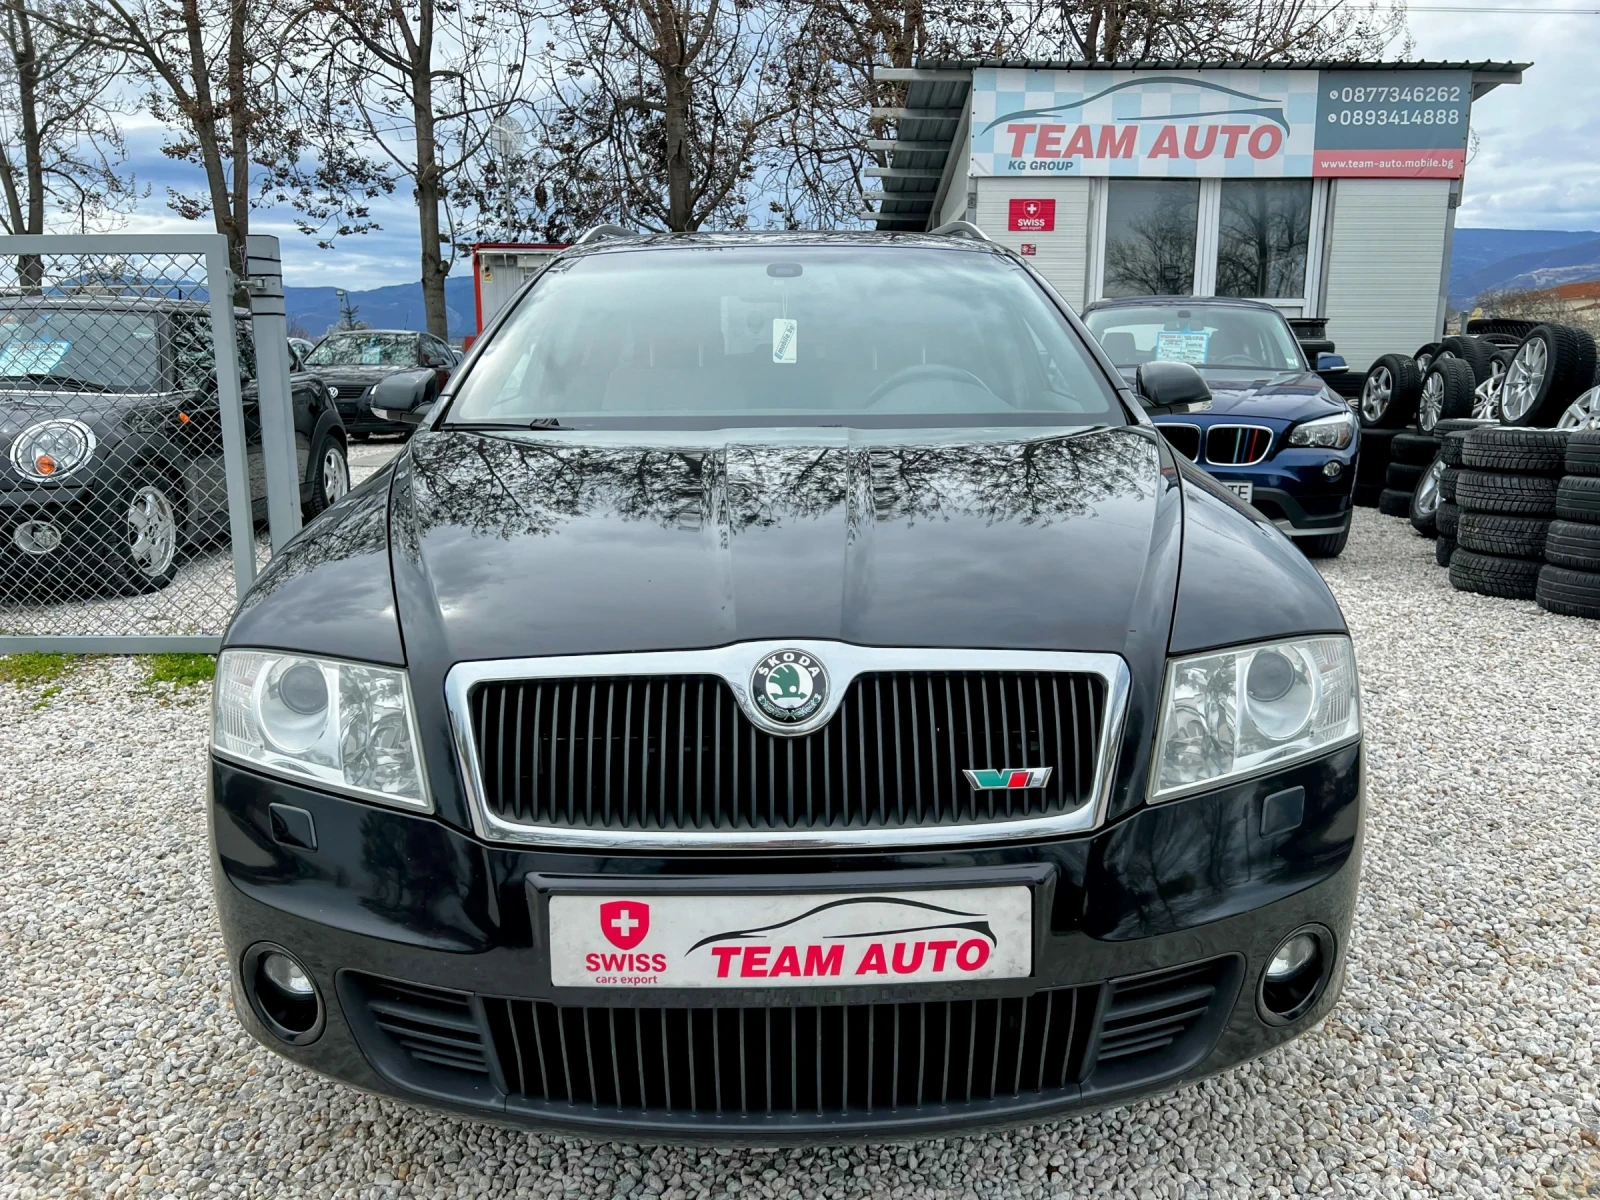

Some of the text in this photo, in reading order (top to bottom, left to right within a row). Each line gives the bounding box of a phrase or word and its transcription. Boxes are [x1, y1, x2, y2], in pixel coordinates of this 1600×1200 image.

[1341, 87, 1460, 102] 0877346262
[1340, 109, 1459, 125] 0893414888
[1007, 124, 1282, 159] TEAM AUTO
[1008, 160, 1073, 170] KG GROUP
[1321, 158, 1453, 169] www.team-auto.mobile.bg
[585, 953, 667, 972] SWISS
[711, 938, 990, 978] TEAM AUTO
[595, 975, 658, 986] cars export
